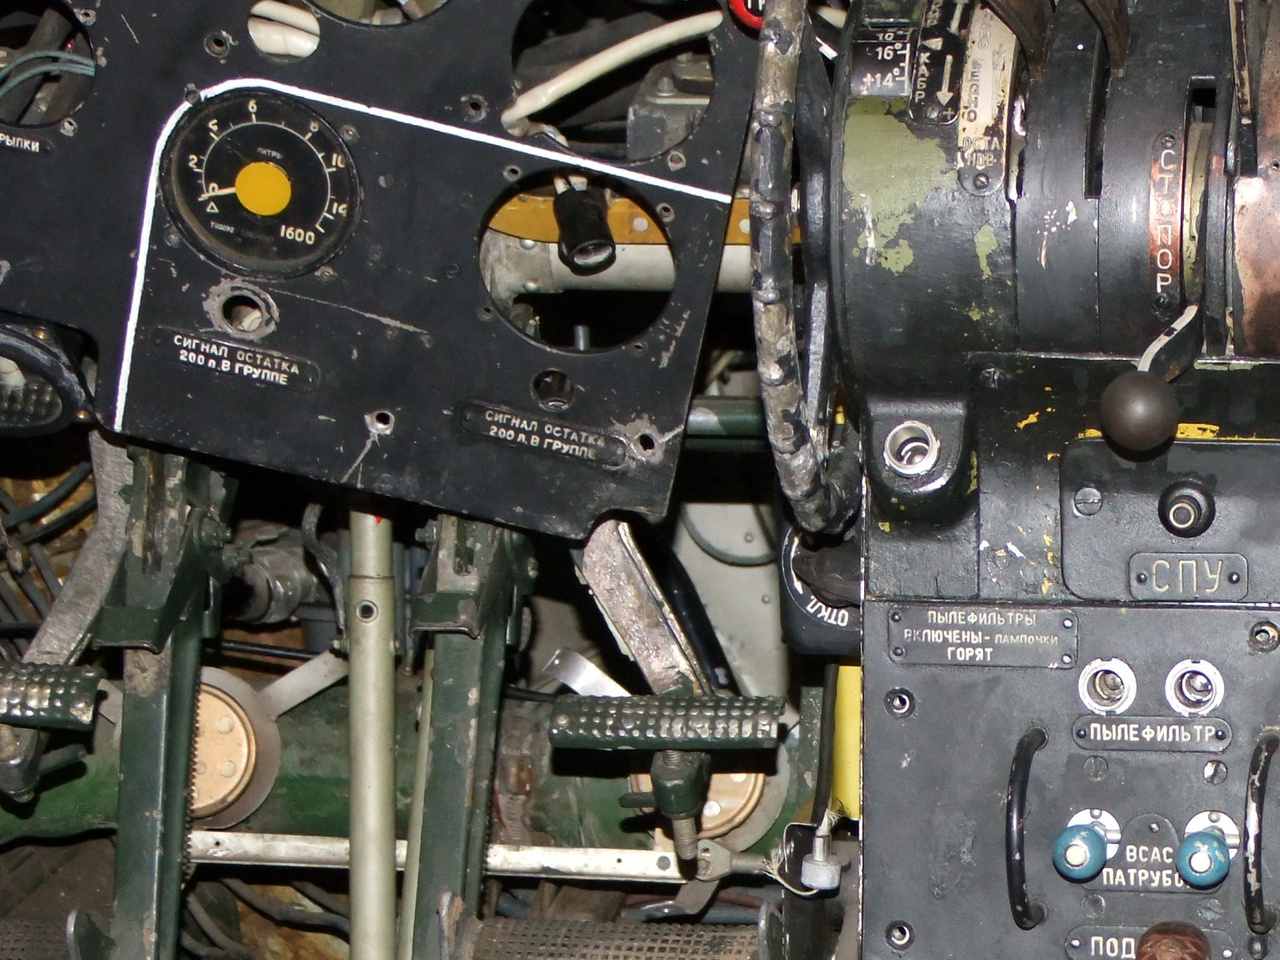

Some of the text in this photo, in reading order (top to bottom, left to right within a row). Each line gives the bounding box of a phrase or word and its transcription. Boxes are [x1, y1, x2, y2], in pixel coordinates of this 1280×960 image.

[248, 100, 258, 113] 6
[189, 155, 198, 168] 2
[1156, 150, 1176, 294] СТОПОР
[280, 224, 315, 245] 1600
[173, 334, 300, 375] СИГНАЛ ОСТАТКА
[179, 349, 205, 366] 200
[234, 362, 289, 385] ГРУППЕ
[485, 410, 605, 448] СИГНАЛ ОСТАТКА
[489, 425, 515, 441] 200
[543, 439, 597, 460] ГРУППЕ
[1152, 559, 1223, 593] СПУ
[928, 610, 1037, 627] ПЫЛЕФИЛЬТРЫ
[995, 633, 1059, 646] ЛАМПОЧКИ
[947, 646, 994, 662] ГОРЯТ
[1089, 722, 1217, 742] ПЫЛЕФИЛЬТР
[1126, 845, 1174, 863] ВСАС
